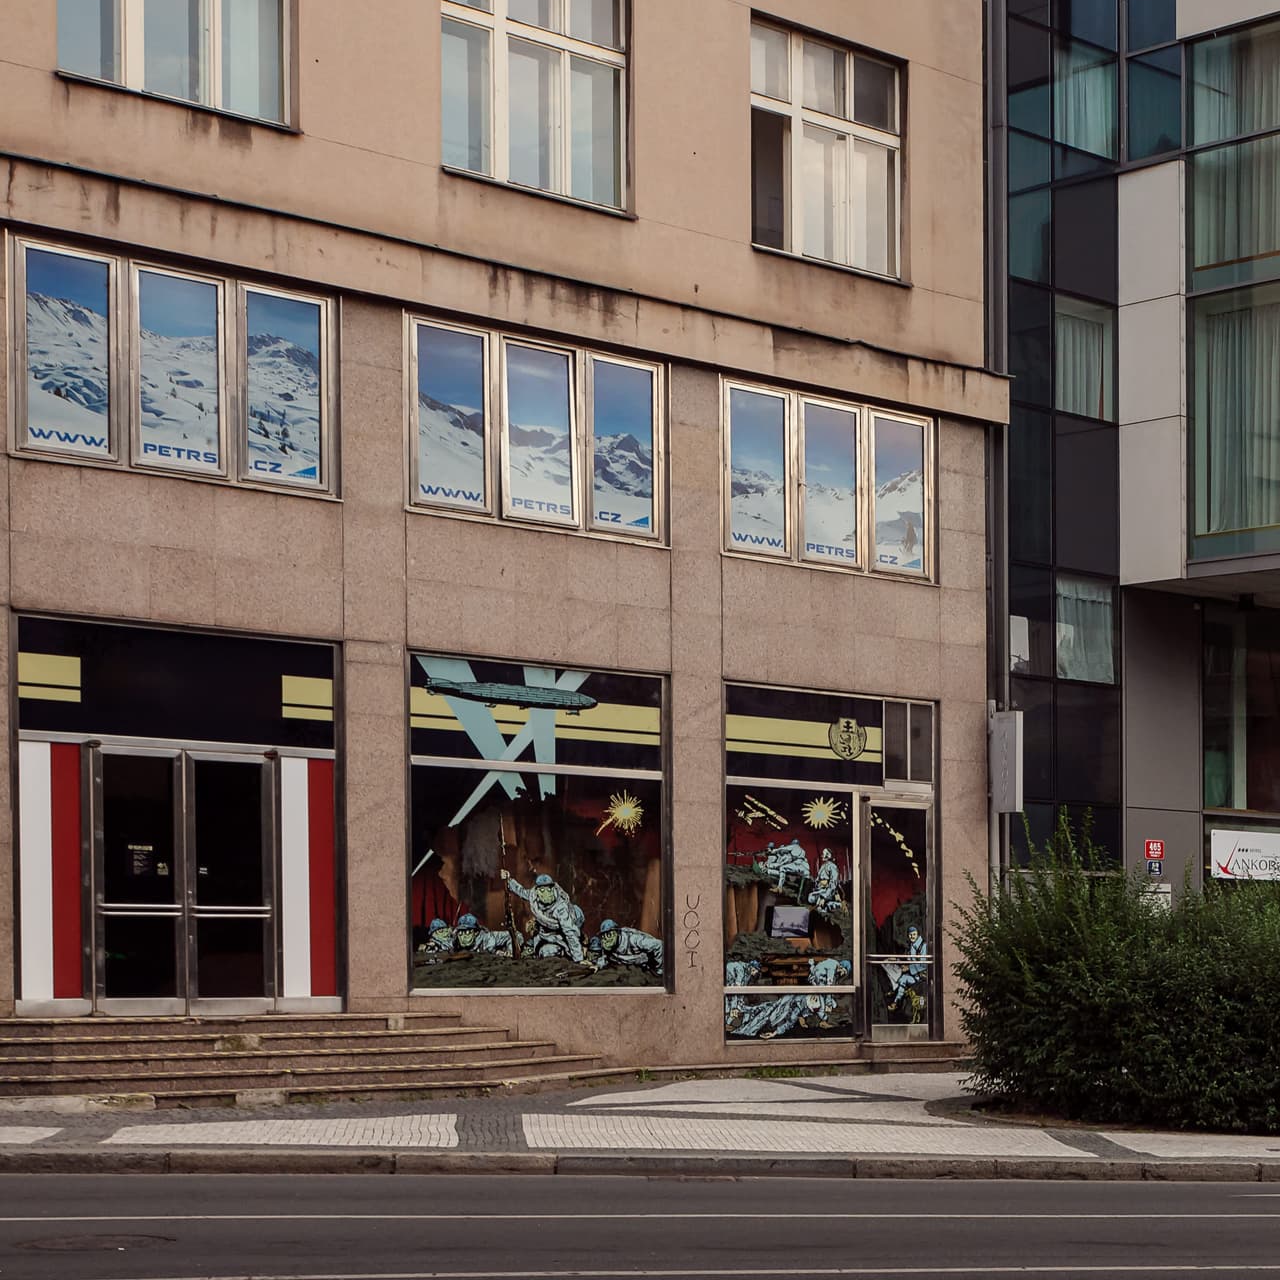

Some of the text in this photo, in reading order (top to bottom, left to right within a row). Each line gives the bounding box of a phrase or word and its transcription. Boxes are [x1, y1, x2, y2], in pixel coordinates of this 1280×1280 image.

[143, 442, 218, 465] PETRS
[511, 496, 571, 516] PETRS
[806, 542, 855, 559] PETRS
